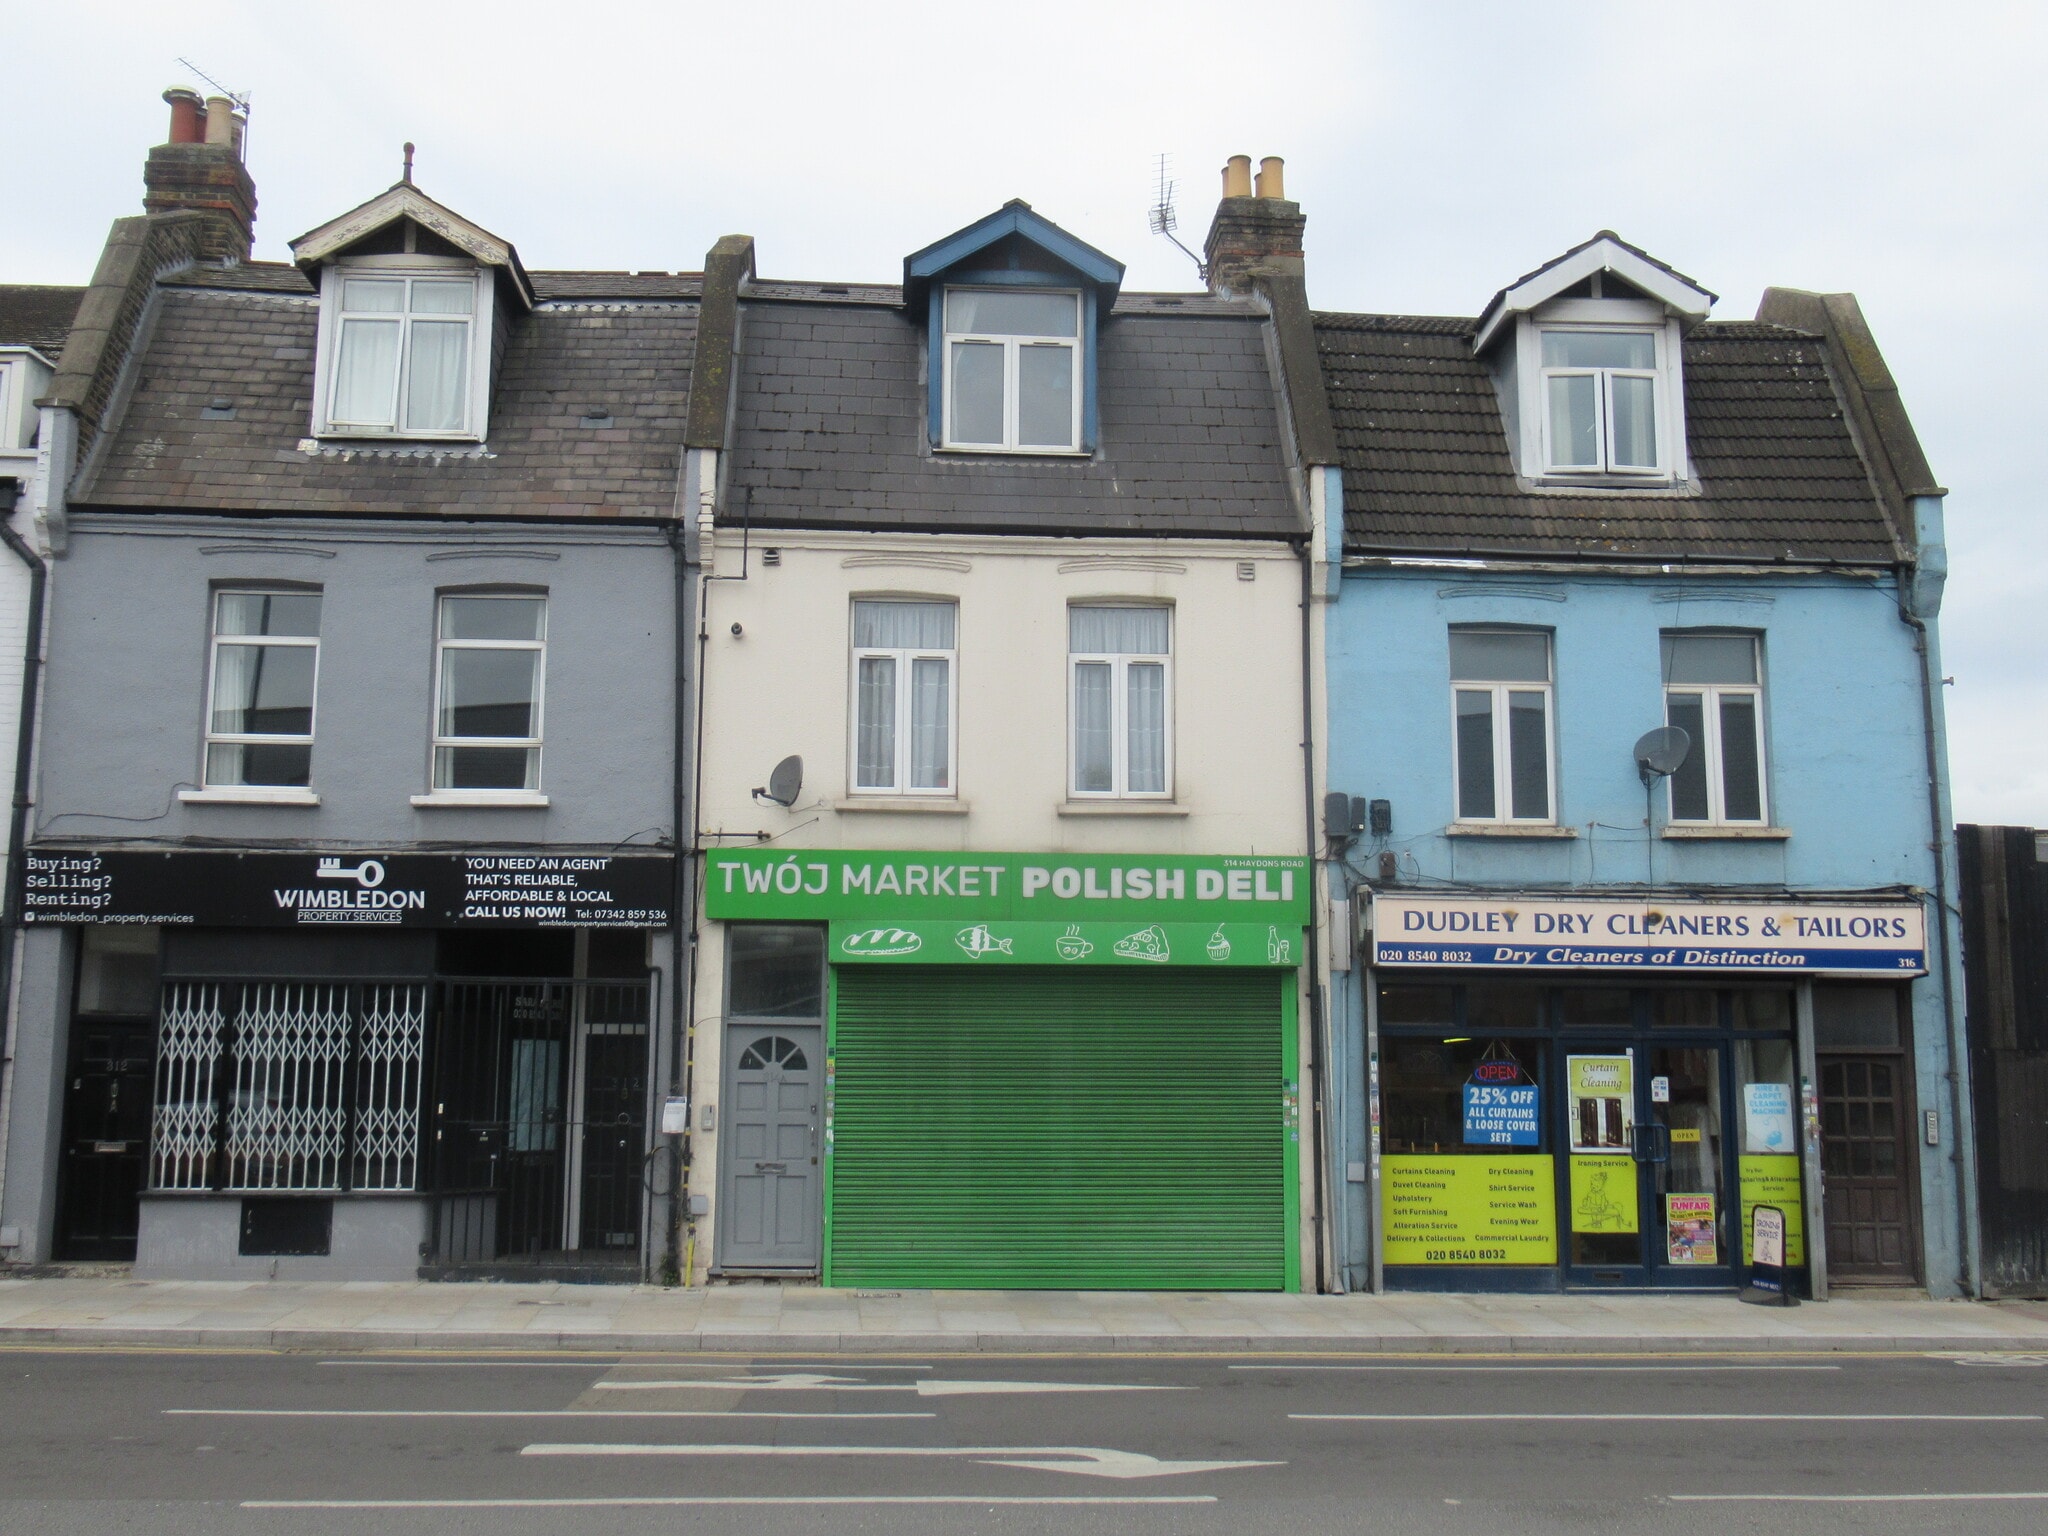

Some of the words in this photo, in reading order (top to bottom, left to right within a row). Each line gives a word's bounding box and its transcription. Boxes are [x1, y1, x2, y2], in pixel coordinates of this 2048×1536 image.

[26, 856, 102, 873] Buying?
[466, 858, 495, 869] YOU
[499, 858, 536, 870] NEED
[538, 859, 559, 870] AN
[561, 859, 608, 870] AGENT
[1223, 859, 1238, 868] 314
[1239, 860, 1279, 868] HAYDONS
[1281, 860, 1304, 868] ROAD
[26, 874, 112, 891] Selling?
[465, 874, 511, 886] THAT'S
[514, 875, 578, 887] RELIABLE,
[717, 854, 828, 894] TWÓJ
[842, 863, 1005, 897] MARKET
[1022, 866, 1185, 900] POLISH
[1196, 869, 1293, 901] DELI
[25, 893, 112, 909] Renting?
[274, 890, 425, 908] WIMBLEDON
[465, 890, 553, 901] AFFORDABLE
[557, 891, 567, 901] &
[570, 891, 613, 902] LOCAL
[297, 911, 351, 921] PROPERTY
[353, 911, 402, 922] SERVICES
[465, 906, 499, 918] CALL
[502, 907, 521, 918] US
[524, 907, 566, 918] NOW!
[576, 910, 592, 919] Tel:
[595, 910, 625, 919] 07342
[628, 910, 646, 919] 859
[648, 910, 667, 920] 536
[37, 912, 194, 925] wimbledon_property.services
[1403, 910, 1519, 932] DUDLEY
[1534, 912, 1594, 933] DRY
[1607, 913, 1749, 936] CLEANERS
[1761, 916, 1781, 937] &
[1793, 916, 1906, 938] TAILORS
[1380, 950, 1402, 961] 020
[1408, 950, 1437, 961] 8540
[1442, 951, 1472, 962] 8032
[1494, 947, 1537, 965] Dry
[1546, 948, 1643, 963] Cleaners
[1651, 949, 1676, 963] of
[1683, 950, 1805, 965] Distinction
[1898, 957, 1916, 967] 316
[106, 1060, 128, 1071] 312
[1583, 1062, 1619, 1073] Curtain
[1479, 1065, 1517, 1079] OPEN
[1580, 1078, 1622, 1090] Cleaning
[1469, 1087, 1507, 1105] 25%
[1510, 1090, 1534, 1104] OFF
[1468, 1107, 1485, 1117] ALL
[1488, 1107, 1534, 1118] CURTAINS
[1466, 1119, 1472, 1129] &
[1475, 1120, 1504, 1130] LOOSE
[1506, 1120, 1536, 1131] COVER
[1490, 1132, 1512, 1143] SETS
[1424, 1168, 1456, 1176] Cleaning
[1488, 1168, 1501, 1176] Dry
[1502, 1168, 1534, 1176] Cleaning
[1392, 1195, 1432, 1203] Upholstery
[1671, 1202, 1710, 1210] FUNFAIR
[1490, 1218, 1518, 1226] Evening
[1756, 1218, 1780, 1230] IRONING
[1757, 1230, 1779, 1240] SERVICE
[1426, 1250, 1446, 1260] 020
[1449, 1250, 1476, 1260] 8540
[1479, 1249, 1506, 1259] 8032
